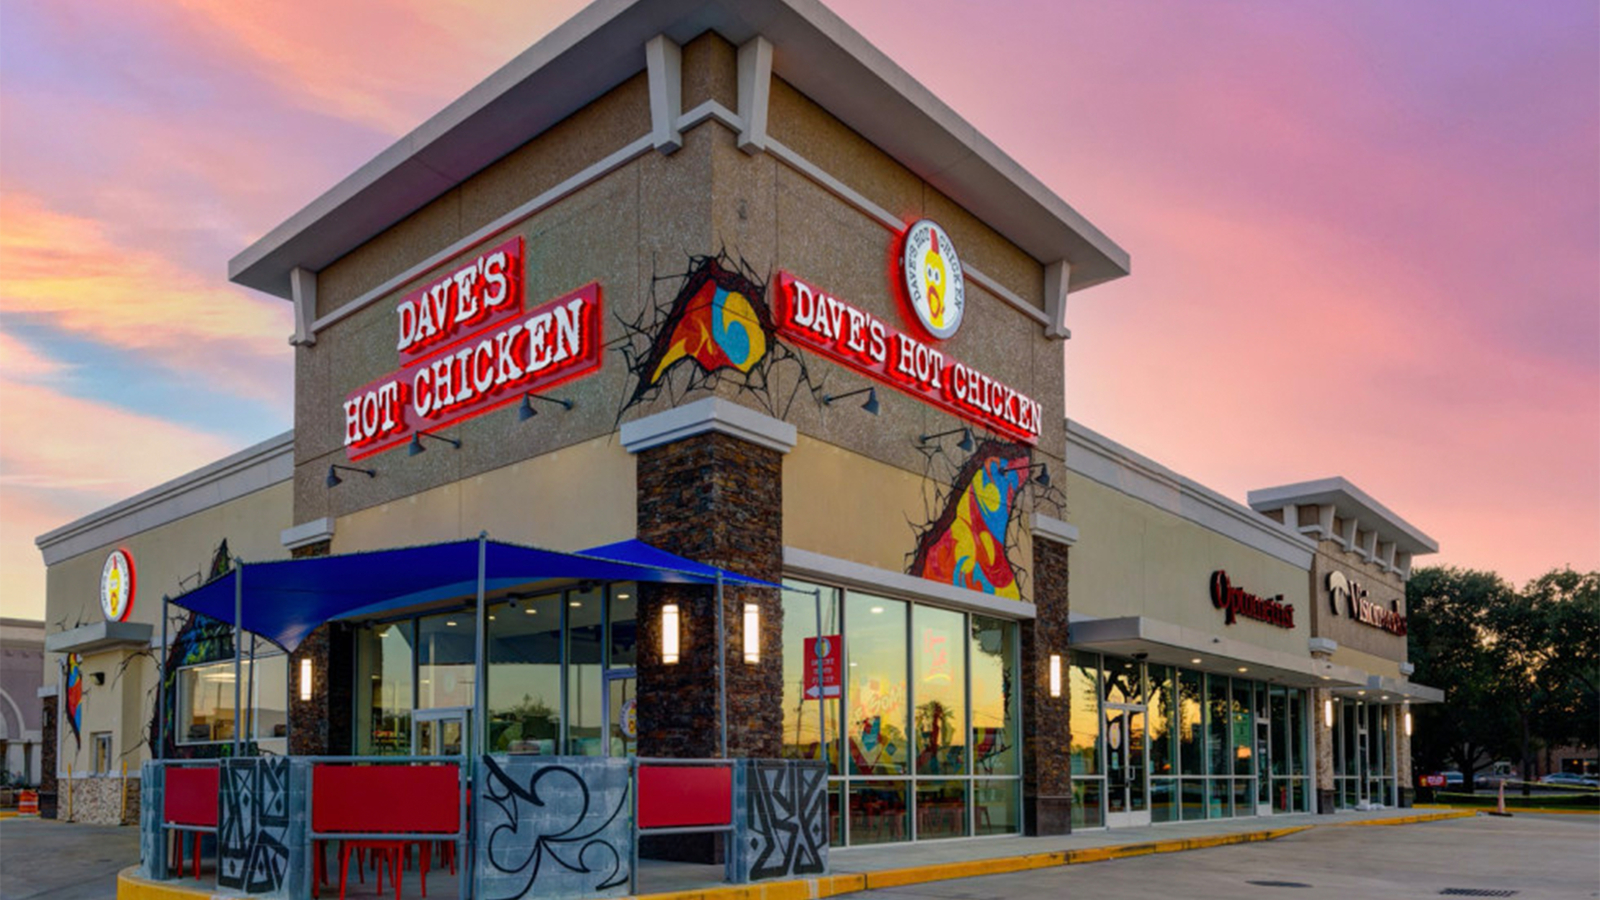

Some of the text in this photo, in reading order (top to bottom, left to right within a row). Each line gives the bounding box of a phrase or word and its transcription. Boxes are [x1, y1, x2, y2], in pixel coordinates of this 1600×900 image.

[343, 298, 584, 446] HOT CHICKEN
[396, 251, 507, 351] DAVE'S
[793, 280, 1042, 436] DAVE'S HOT CHICKEN
